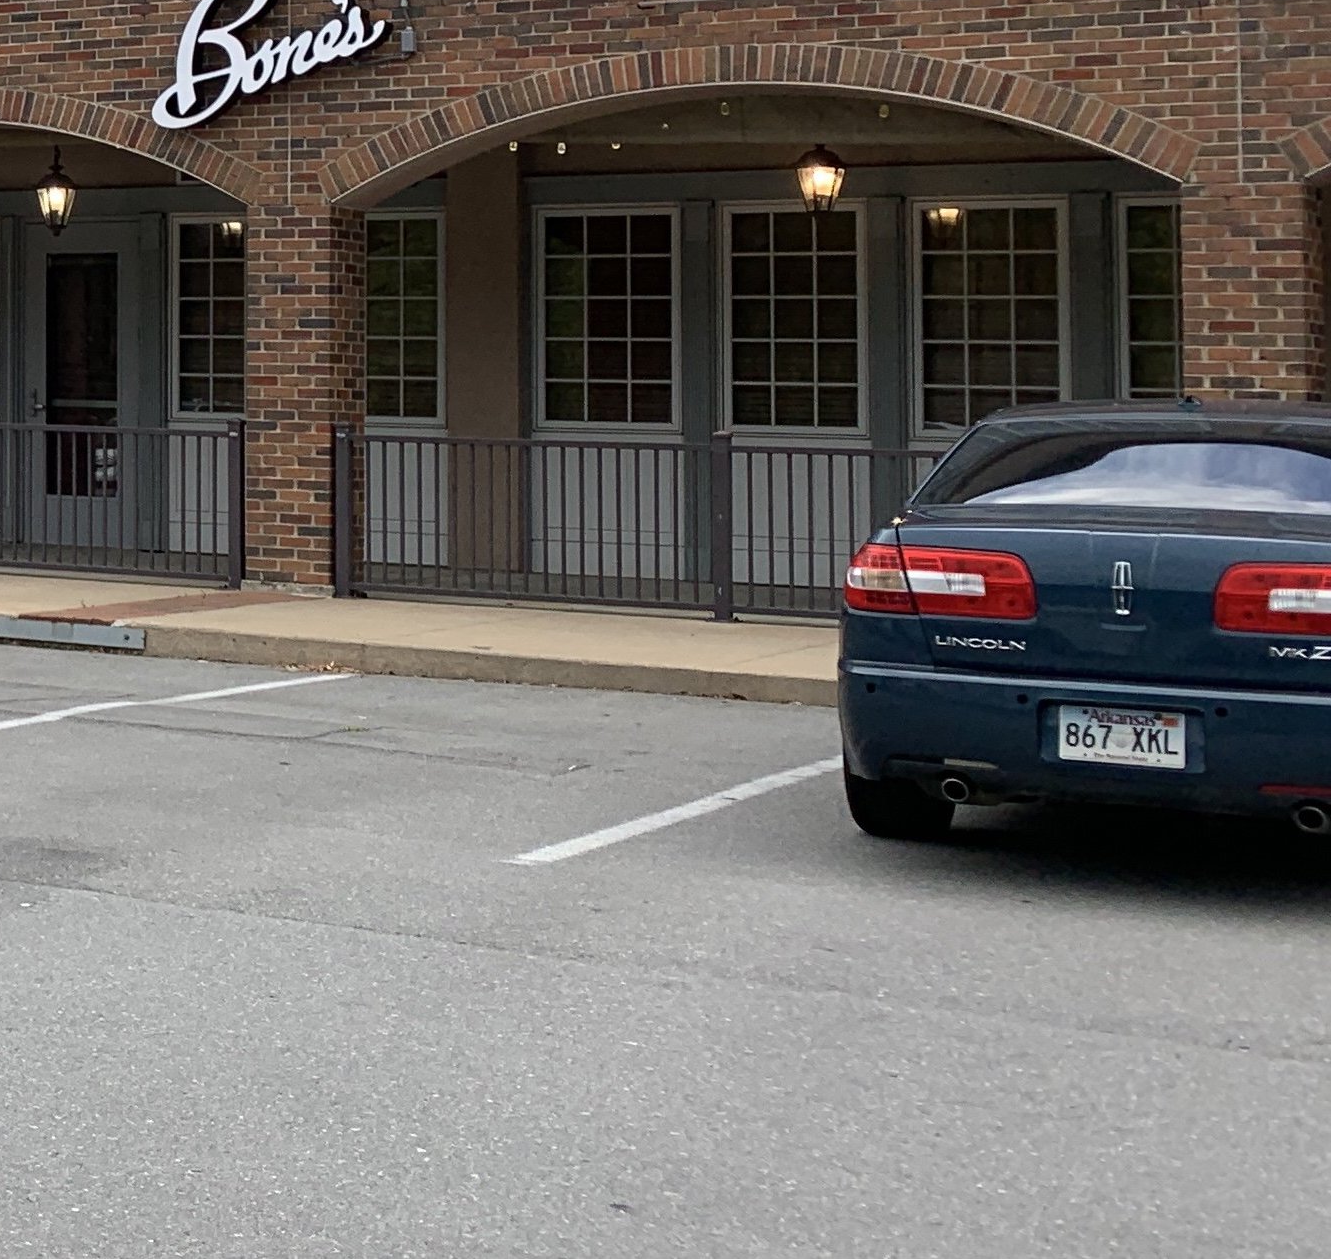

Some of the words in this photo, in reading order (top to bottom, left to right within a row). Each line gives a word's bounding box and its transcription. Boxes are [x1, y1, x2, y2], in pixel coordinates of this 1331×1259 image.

[935, 635, 1027, 651] LINCOLN
[1089, 708, 1157, 727] Arkansas
[1066, 722, 1113, 750] 867
[1131, 726, 1179, 755] XKL
